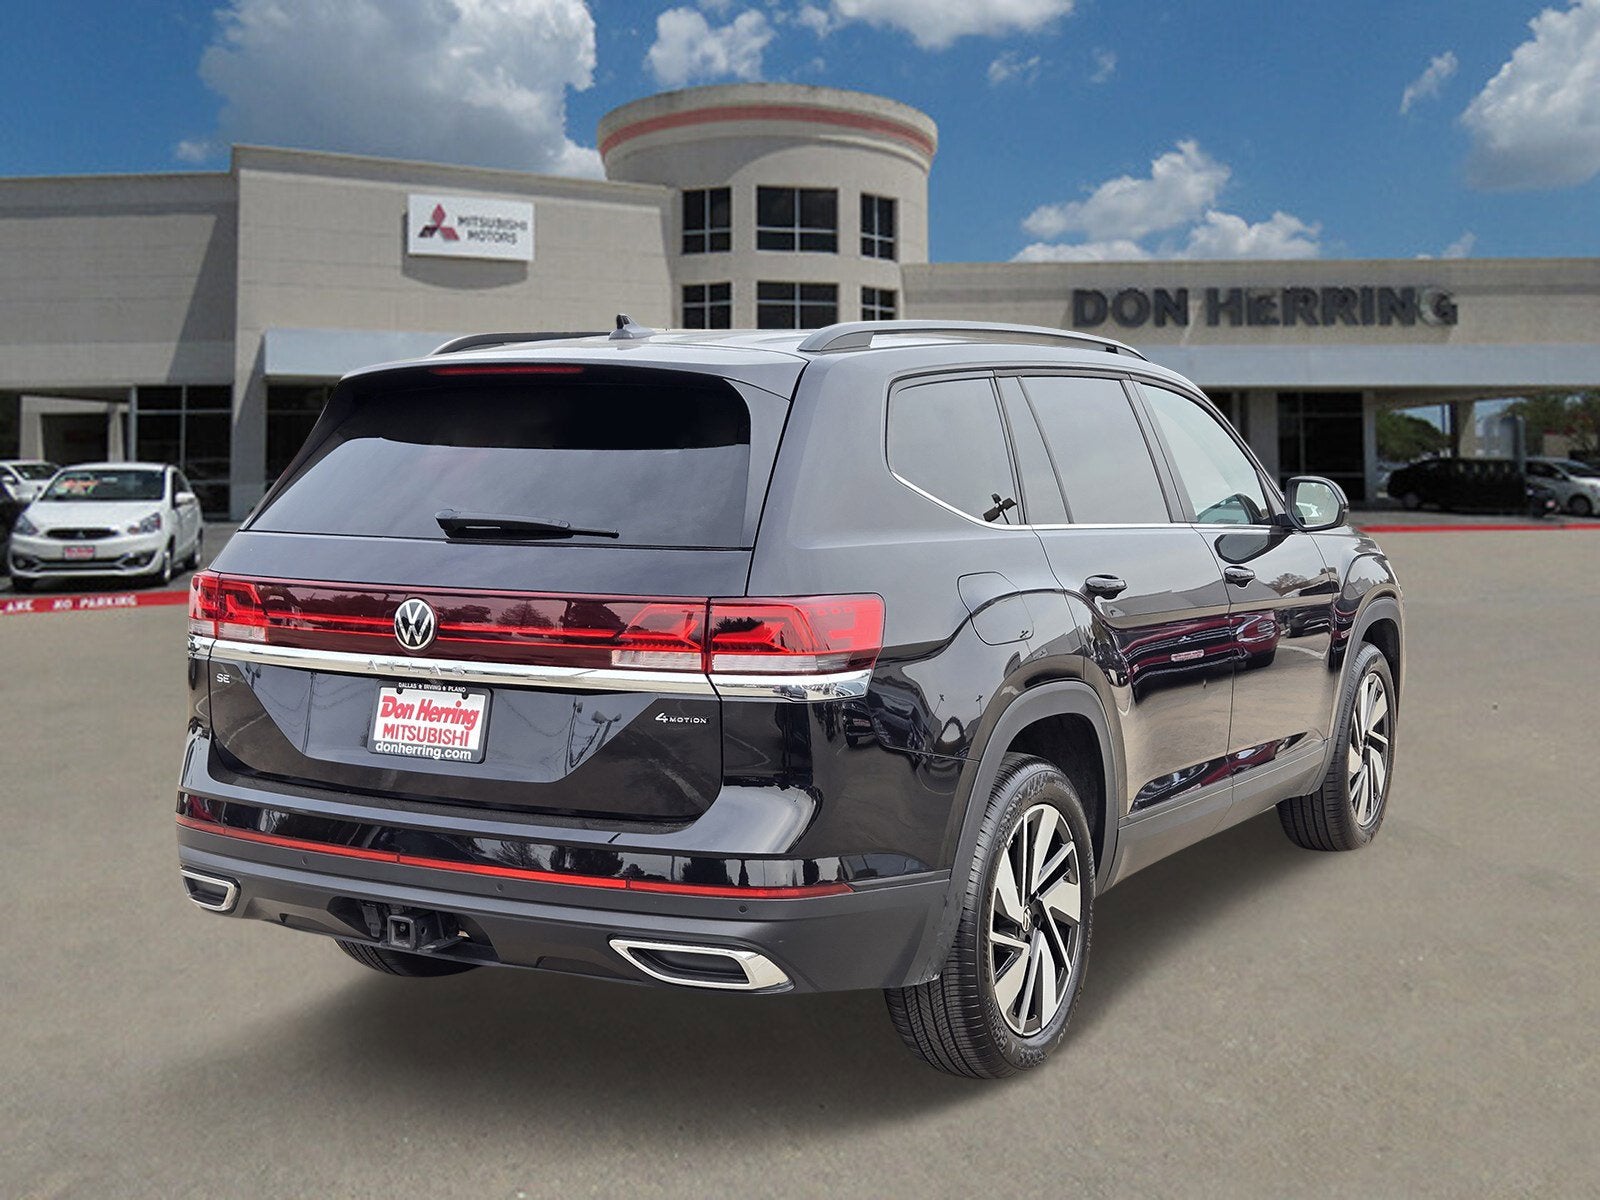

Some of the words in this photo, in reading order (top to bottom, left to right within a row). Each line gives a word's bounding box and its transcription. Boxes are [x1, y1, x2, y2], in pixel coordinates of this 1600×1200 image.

[457, 216, 528, 231] MITSUBISHI
[467, 230, 518, 245] MOTORS
[1072, 287, 1189, 328] DON
[1205, 285, 1459, 327] HERRING
[367, 660, 466, 677] ATLAS
[216, 673, 231, 684] SE
[423, 683, 442, 691] IRVING
[447, 685, 467, 693] PLANO
[380, 695, 415, 720] Don
[415, 698, 480, 731] Herring
[382, 723, 471, 747] MITSUBISHI
[375, 741, 472, 760] donherring.com
